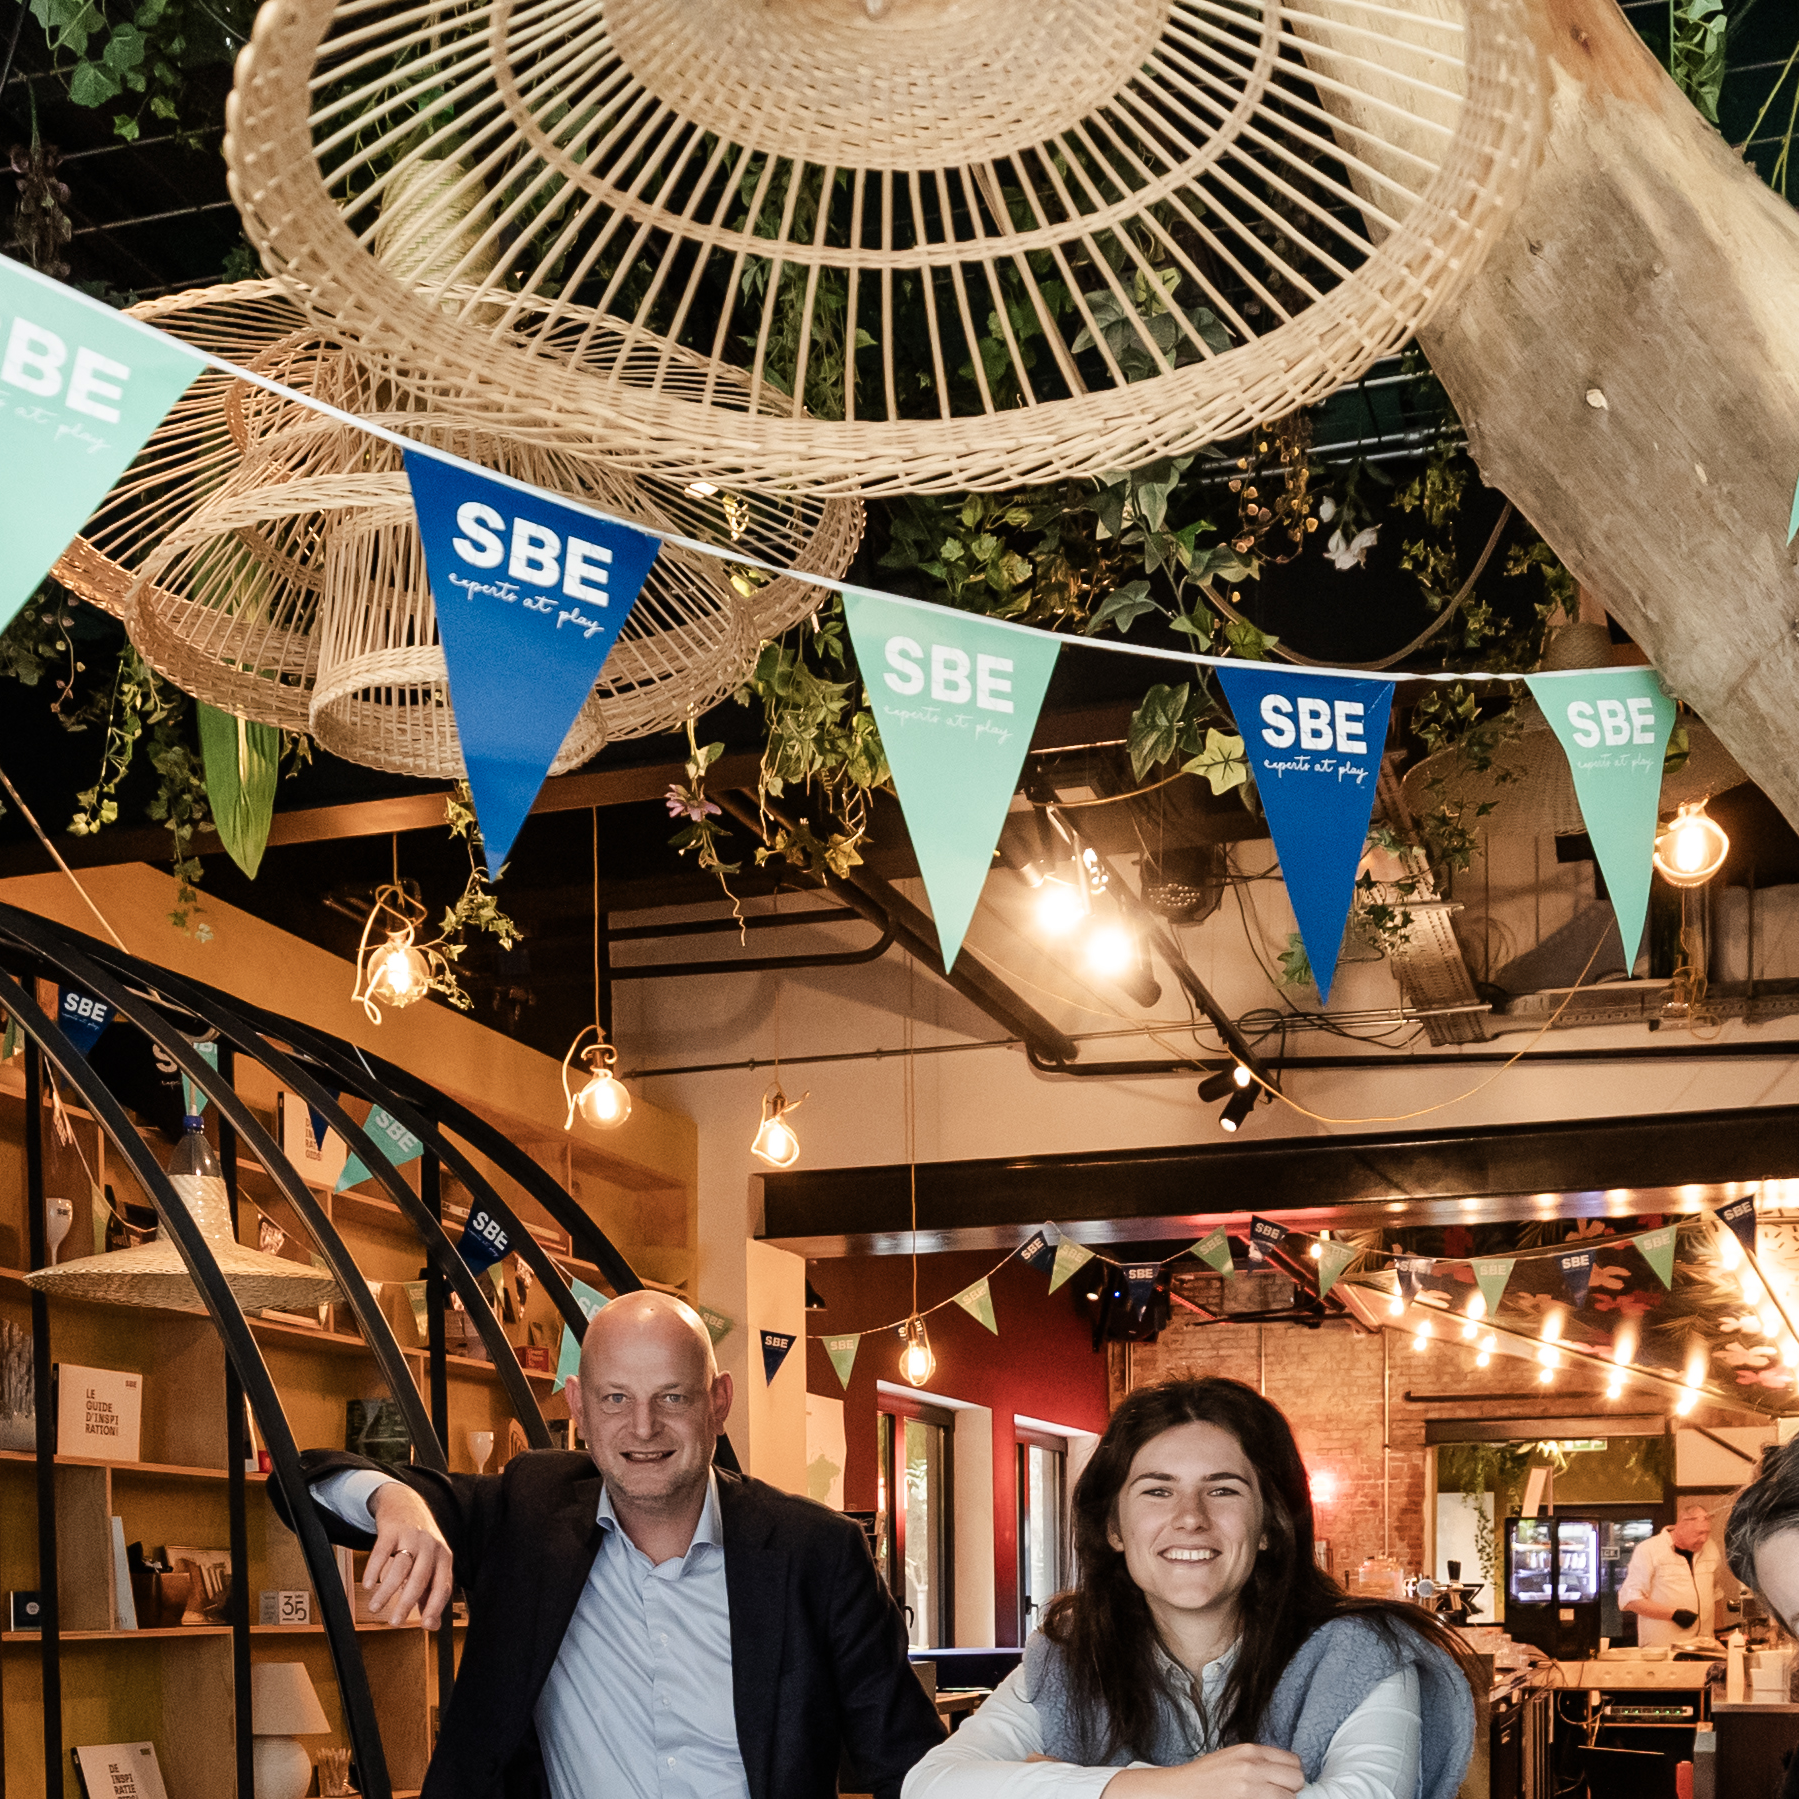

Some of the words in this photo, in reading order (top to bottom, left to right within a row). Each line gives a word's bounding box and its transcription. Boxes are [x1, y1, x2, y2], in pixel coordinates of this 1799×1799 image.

[452, 501, 613, 608] SBE
[448, 572, 521, 603] experts
[522, 596, 559, 614] at
[556, 607, 605, 639] play
[883, 635, 1014, 714] SBE
[883, 704, 941, 726] experts
[946, 714, 974, 728] at
[975, 719, 1014, 745] play
[1260, 693, 1368, 755] SBE
[1567, 697, 1655, 748] SBE
[1263, 755, 1311, 778] experts
[1314, 758, 1337, 773] at
[1338, 761, 1369, 784] play
[64, 993, 107, 1023] SBE
[375, 1111, 419, 1153] SBE
[1723, 1201, 1753, 1220] SBE
[473, 1211, 509, 1251] SBE
[1254, 1222, 1281, 1240] SBE
[1020, 1237, 1044, 1260] SBE
[1200, 1234, 1224, 1256] SBE
[1643, 1232, 1671, 1250] SBE
[1061, 1244, 1085, 1263] SBE
[1561, 1254, 1590, 1269] SBE
[1128, 1268, 1154, 1279] SBE
[1479, 1264, 1507, 1275] SBE
[962, 1286, 987, 1305] SBE
[703, 1312, 725, 1329] SBE
[764, 1335, 789, 1349] SBE
[830, 1339, 855, 1351] SBE
[86, 1388, 96, 1399] LE
[85, 1400, 113, 1413] GUIDE
